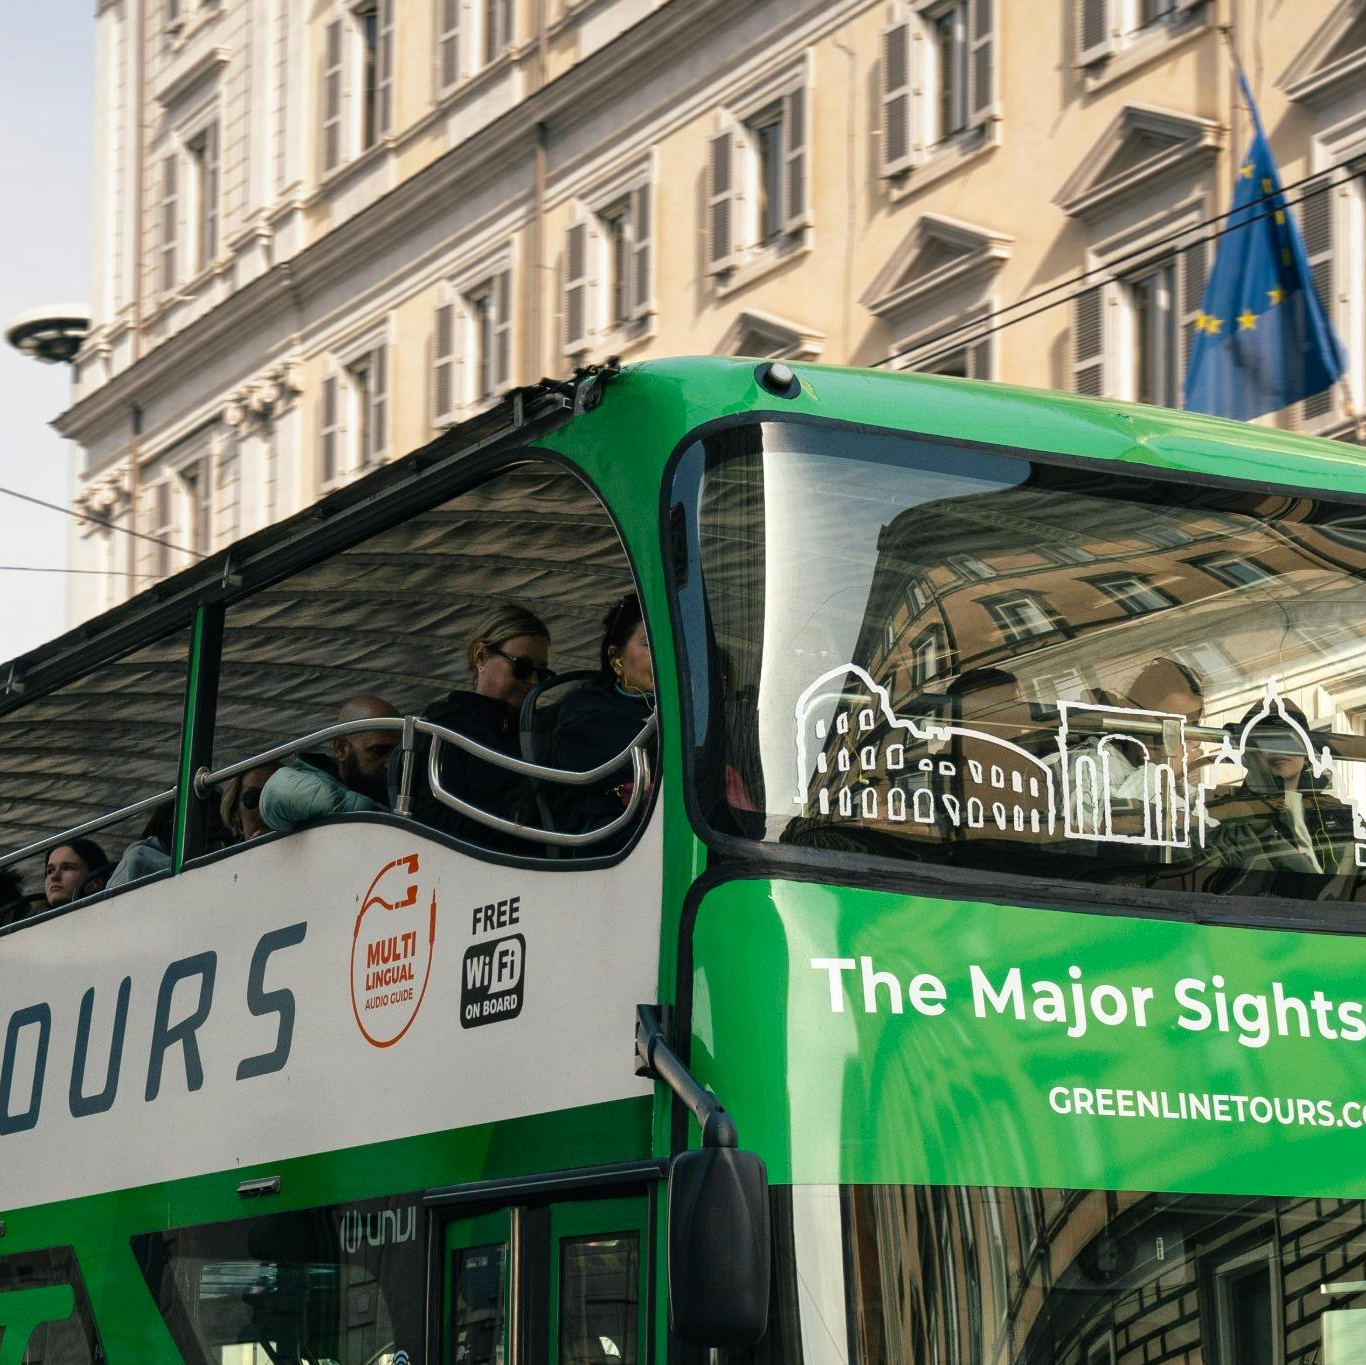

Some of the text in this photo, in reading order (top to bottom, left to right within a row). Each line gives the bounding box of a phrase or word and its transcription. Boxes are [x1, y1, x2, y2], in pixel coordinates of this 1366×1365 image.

[471, 896, 520, 935] FREE
[366, 931, 417, 969] MULTI
[365, 962, 414, 992] LINGUAL
[466, 950, 515, 990] WiFi
[364, 987, 414, 1011] AUDIO GUIDE
[465, 994, 518, 1020] ON BOARD
[810, 956, 948, 1016] The
[972, 964, 1156, 1049] Major
